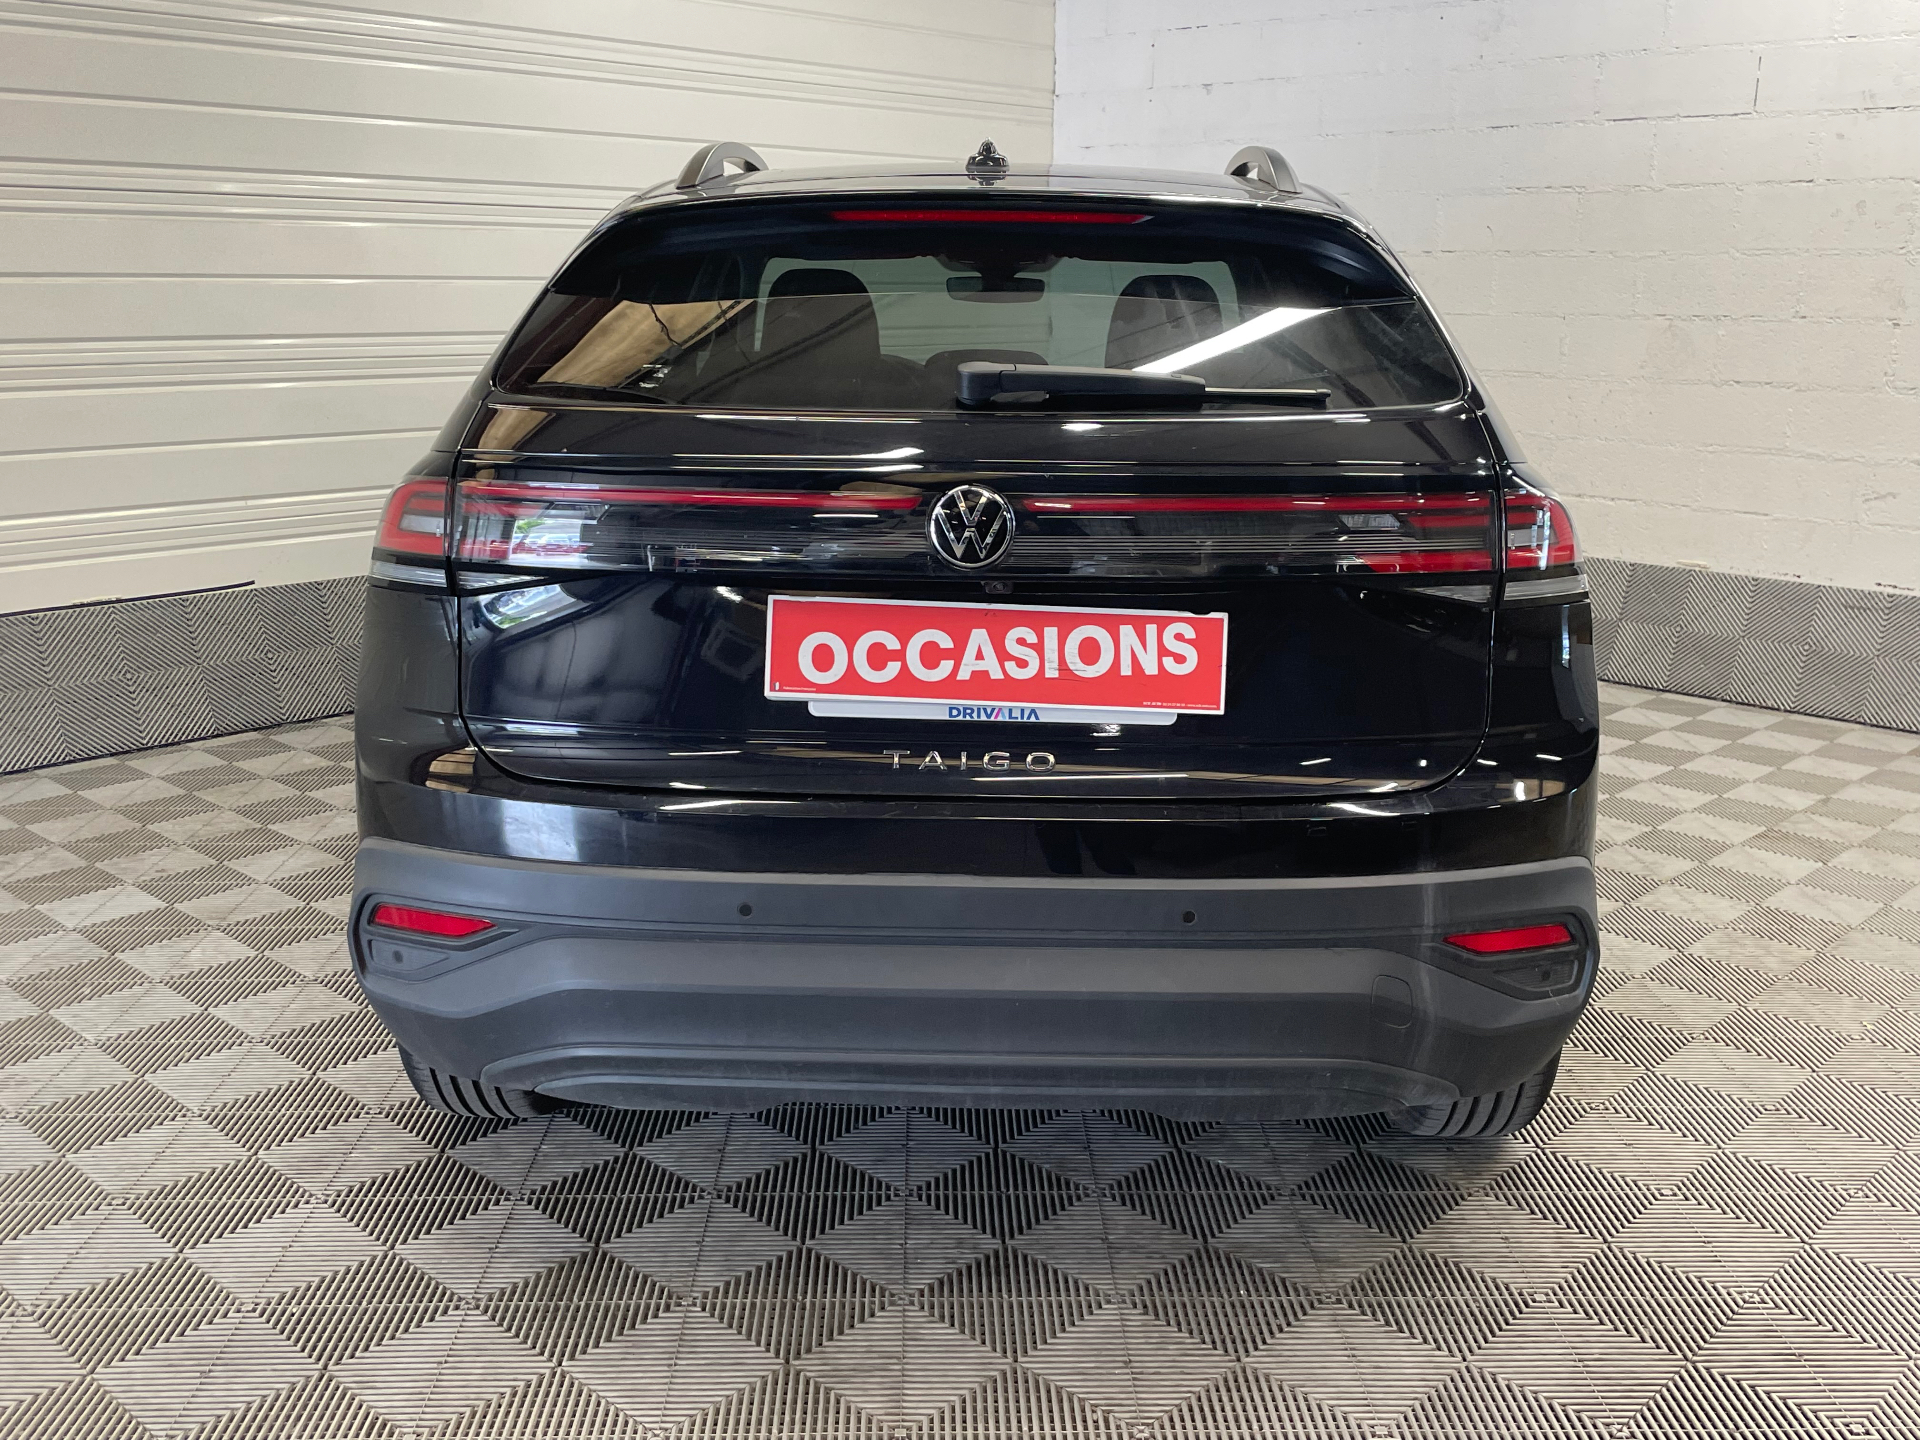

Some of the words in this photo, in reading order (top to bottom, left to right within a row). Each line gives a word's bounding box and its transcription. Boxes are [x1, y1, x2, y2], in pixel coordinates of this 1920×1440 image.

[798, 622, 1199, 683] OCCASIONS
[948, 706, 1040, 721] DRIVALIA
[883, 749, 1057, 773] TAIGO
